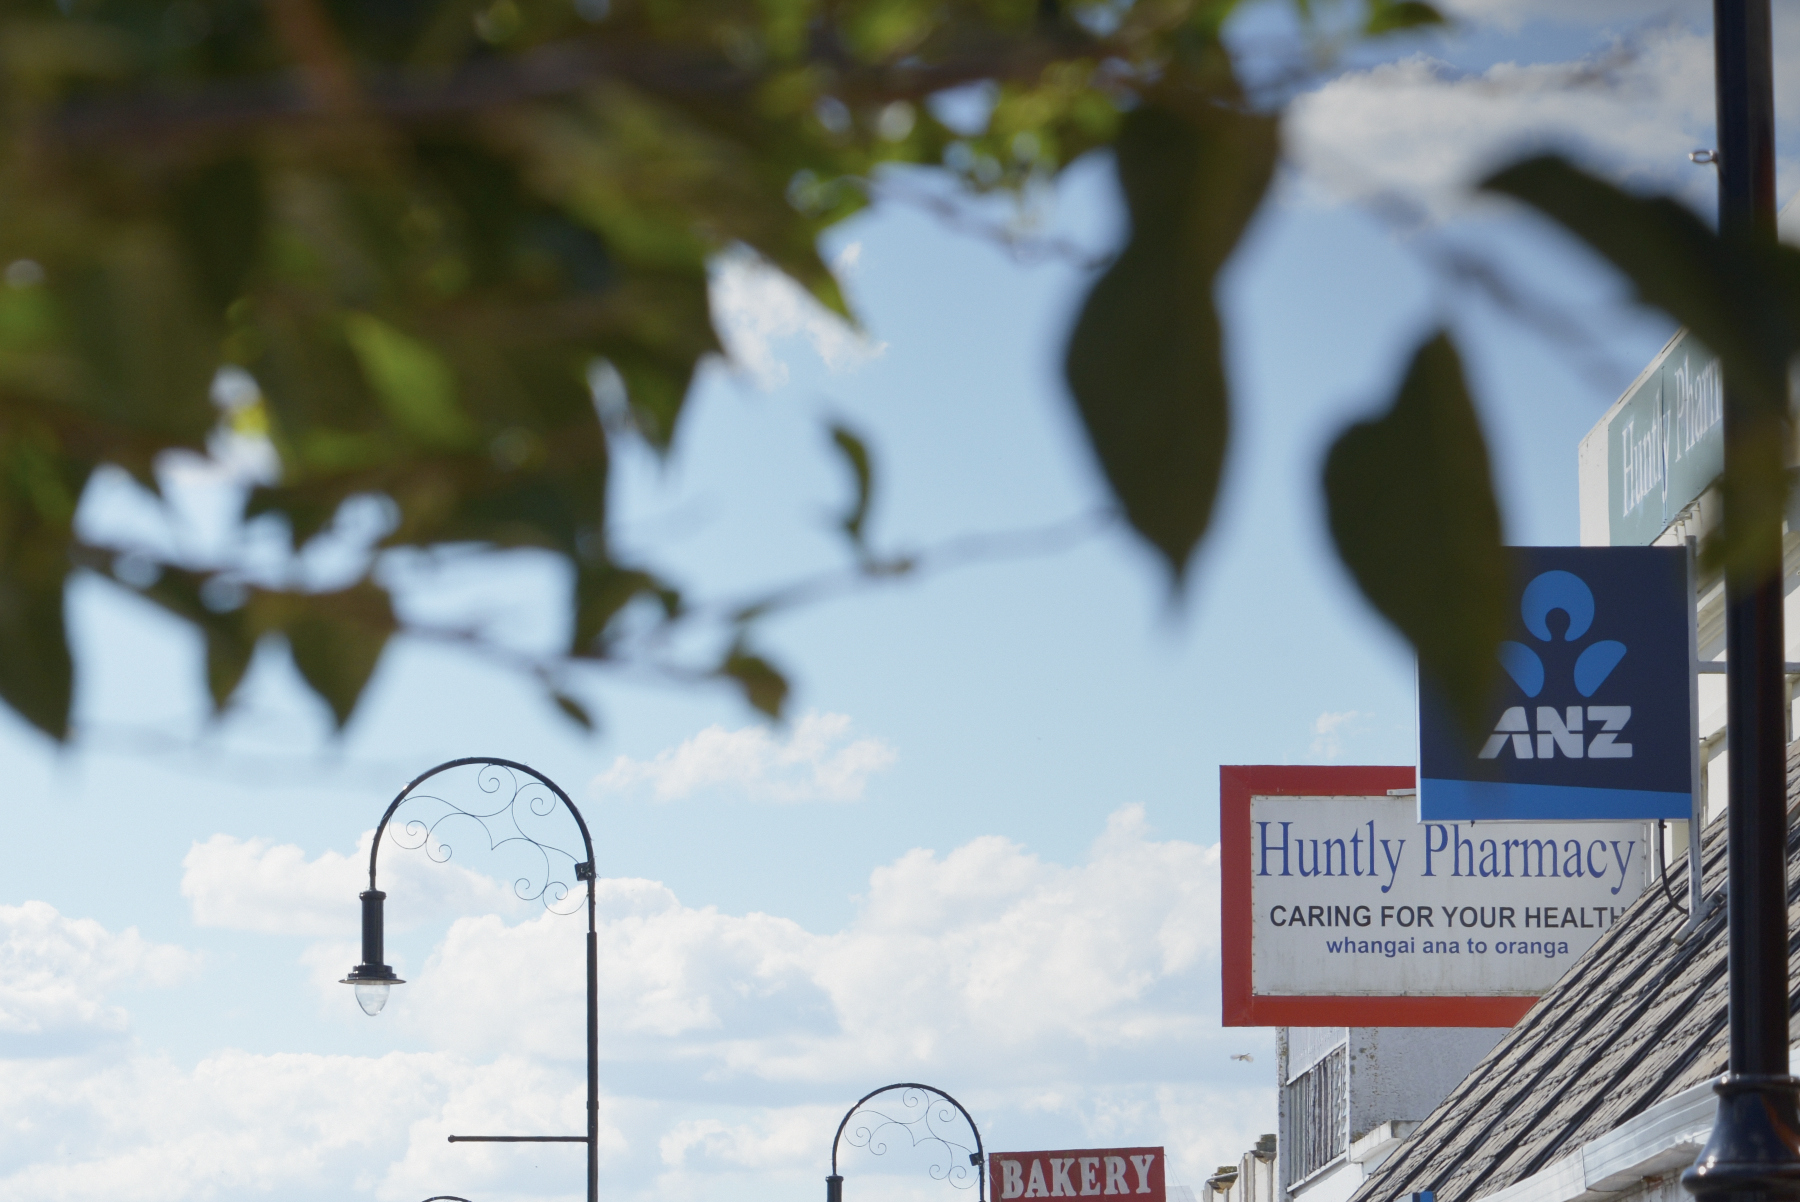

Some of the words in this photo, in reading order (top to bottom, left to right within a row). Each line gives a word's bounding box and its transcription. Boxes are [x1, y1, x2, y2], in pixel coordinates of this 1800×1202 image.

[1622, 386, 1672, 518] Huntly
[1674, 356, 1722, 462] Pharm
[1478, 704, 1634, 760] ANZ
[1256, 820, 1406, 894] Huntly
[1420, 824, 1636, 896] Pharmacy
[1270, 904, 1372, 928] CARING
[1380, 906, 1434, 928] FOR
[1442, 906, 1516, 928] YOUR
[1326, 936, 1416, 958] whangai
[1422, 940, 1460, 954] ana
[1466, 938, 1488, 954] to
[1494, 940, 1570, 960] oranga
[1000, 1154, 1156, 1200] BAKERY
